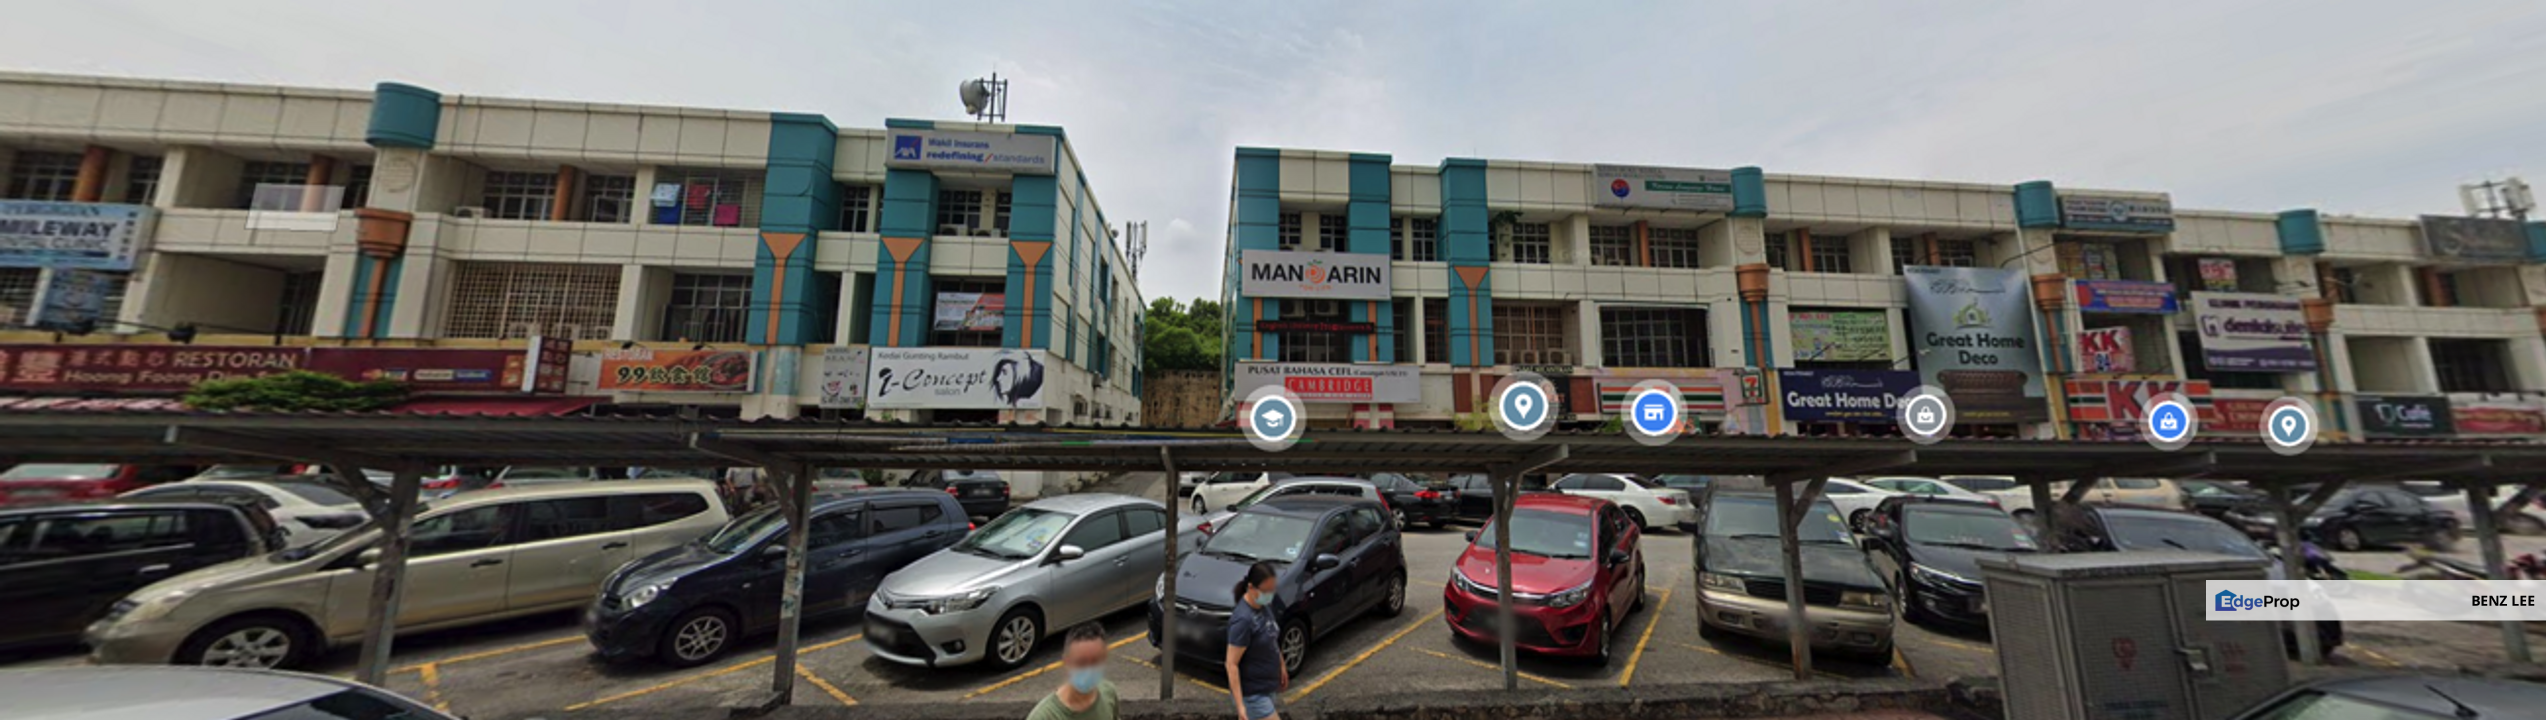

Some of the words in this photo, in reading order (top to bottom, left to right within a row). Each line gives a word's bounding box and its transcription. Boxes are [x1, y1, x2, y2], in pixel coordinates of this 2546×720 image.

[1926, 332, 1973, 347] Great
[1976, 334, 2025, 349] Home
[173, 351, 297, 368] RESTORAN
[1958, 350, 1998, 365] Deco
[1288, 378, 1371, 393] CAMBRIDGE
[1787, 391, 1832, 408] Great
[1835, 392, 1880, 408] Home
